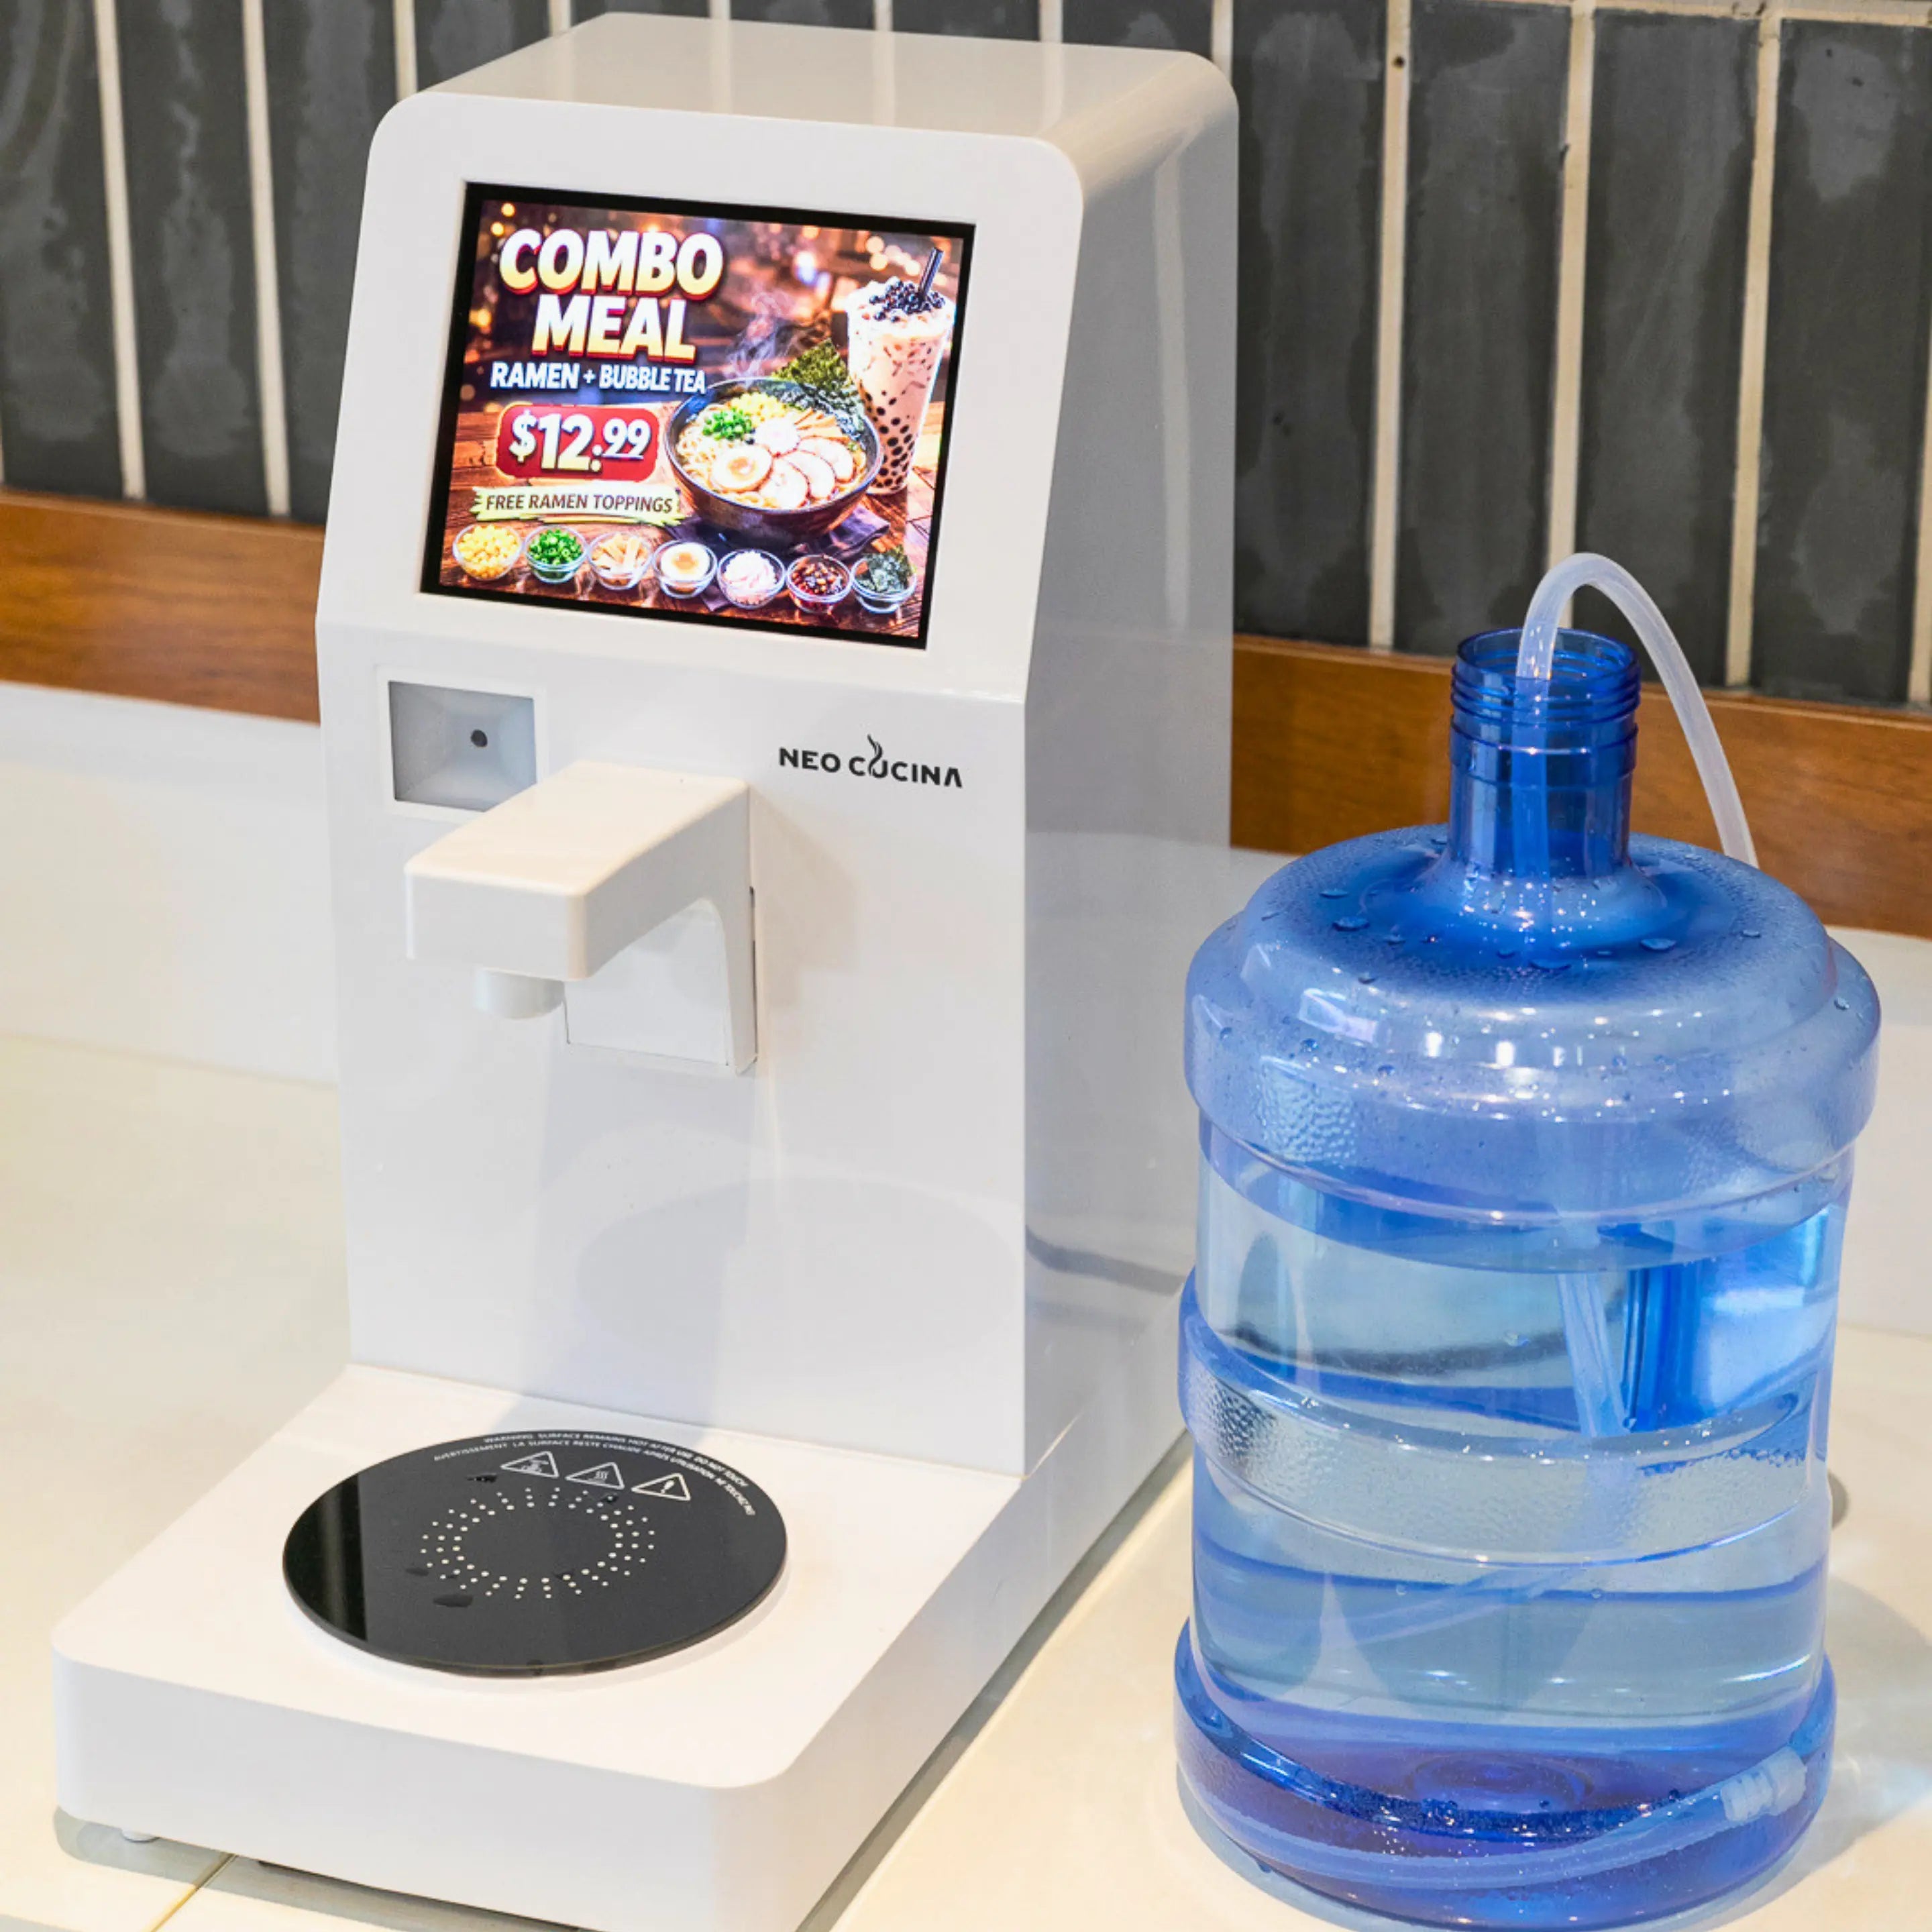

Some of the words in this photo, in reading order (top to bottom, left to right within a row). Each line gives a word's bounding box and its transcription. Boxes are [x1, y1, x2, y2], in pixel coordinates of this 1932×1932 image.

[500, 229, 724, 301] COMBO
[531, 294, 697, 364] MEAL
[490, 362, 580, 388] RAMEN
[598, 365, 672, 392] BUBBLE
[674, 369, 706, 394] TEA
[486, 495, 525, 511] FREE
[528, 494, 588, 510] RAMEN
[594, 495, 673, 514] TOPPINGS
[779, 747, 841, 773] NEO
[849, 735, 963, 788] CUCINA
